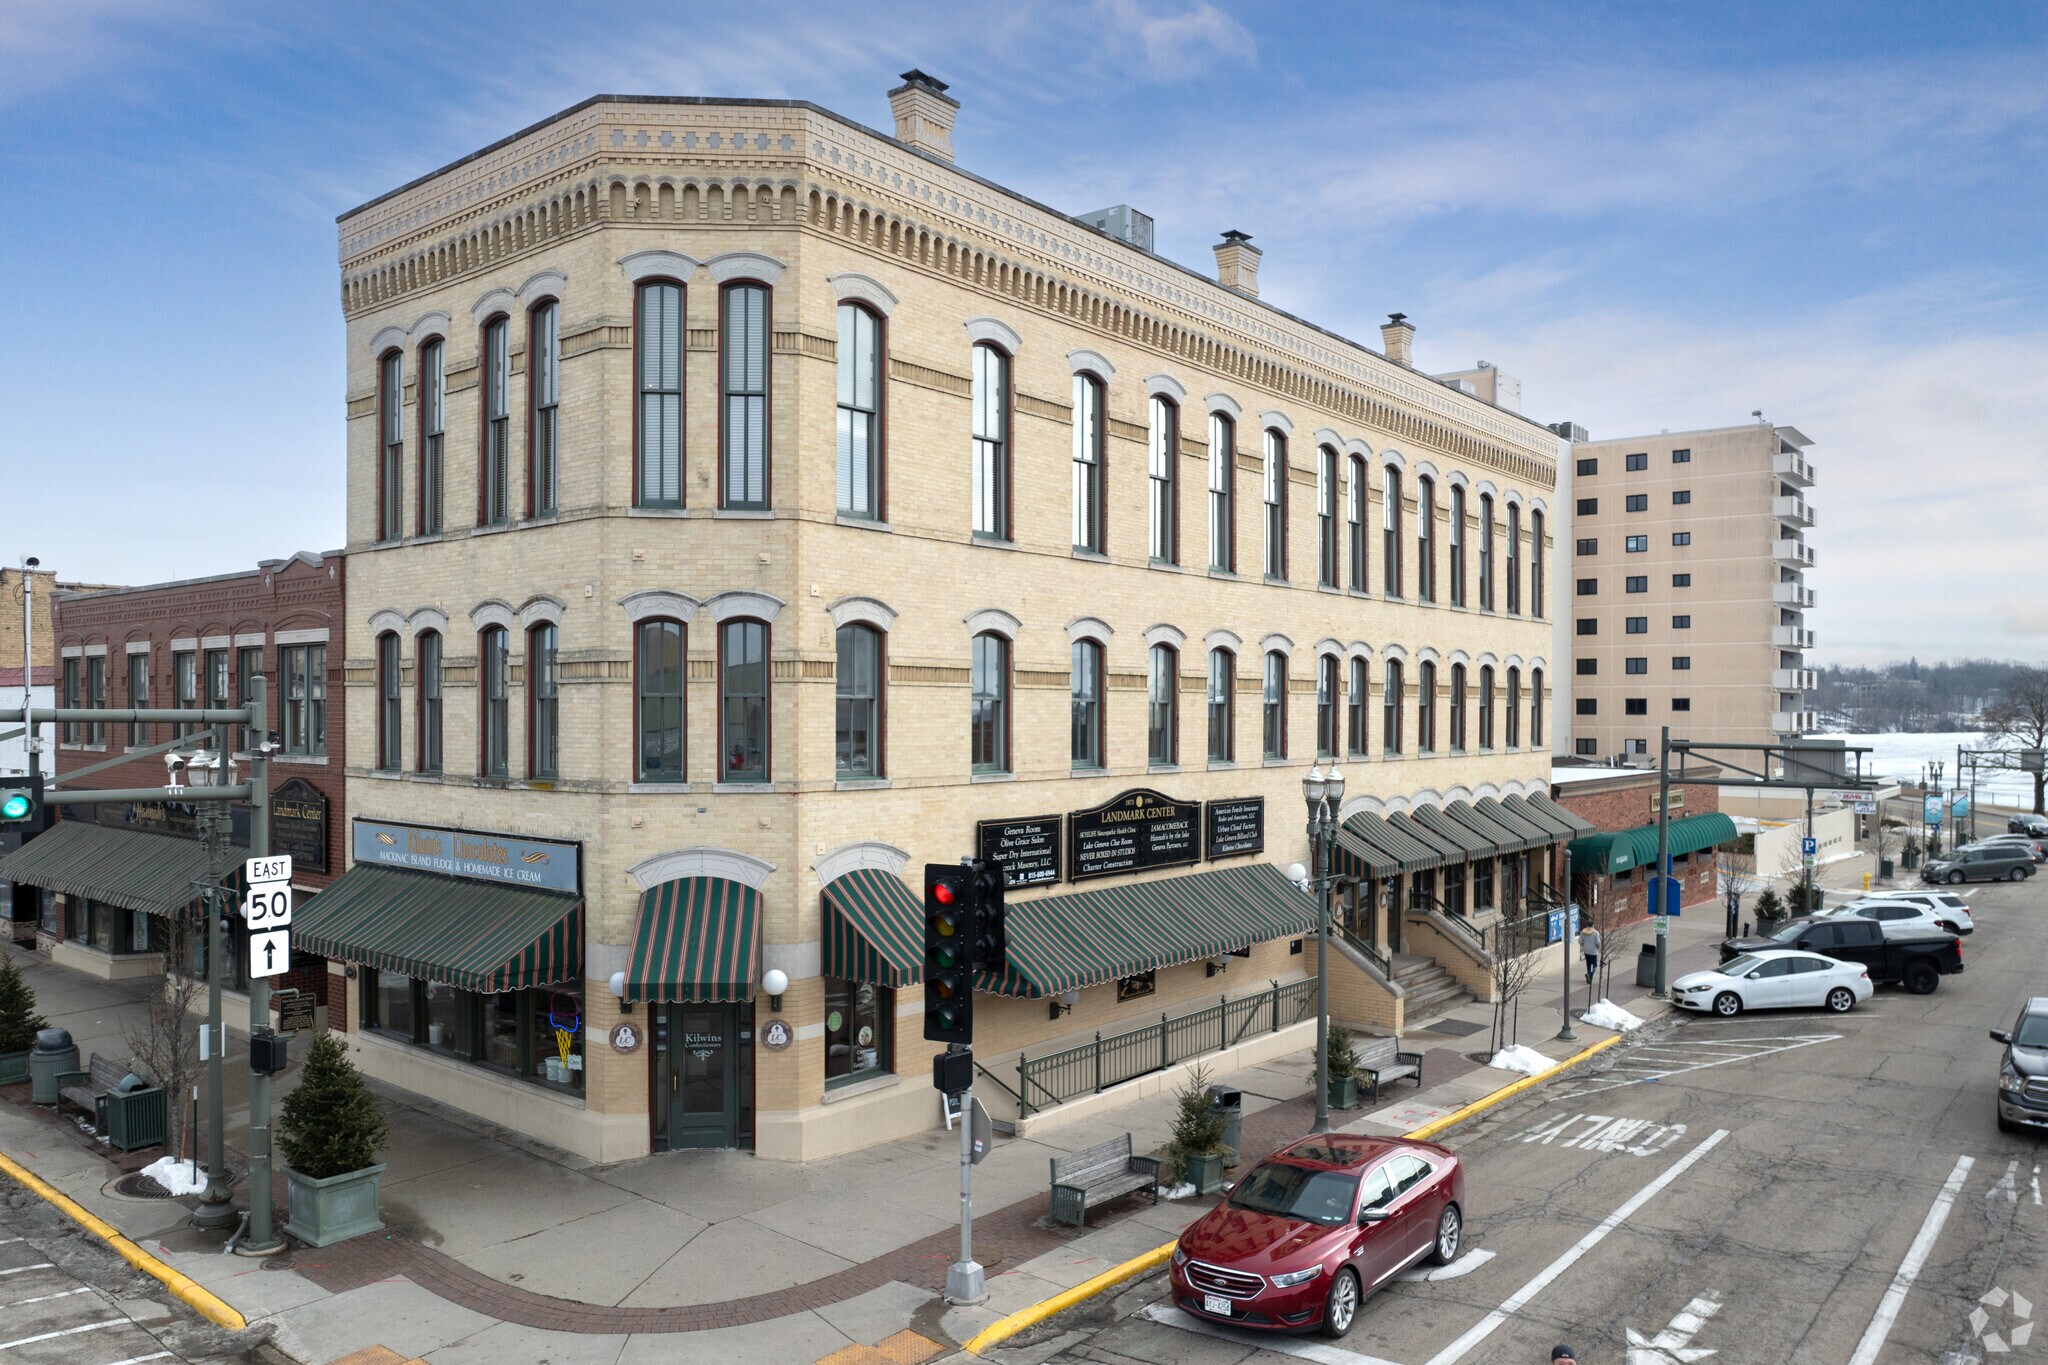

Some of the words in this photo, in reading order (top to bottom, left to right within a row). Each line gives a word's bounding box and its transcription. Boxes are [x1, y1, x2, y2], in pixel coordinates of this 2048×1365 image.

[273, 802, 301, 818] Landmark
[302, 804, 322, 820] Center
[1101, 809, 1145, 823] LANDMARK
[1147, 806, 1176, 819] CENTER
[1232, 806, 1243, 814] Family
[1004, 827, 1024, 836] Geneva
[1025, 825, 1042, 834] Room
[1230, 823, 1242, 832] Cloud
[1242, 823, 1256, 831] Factory
[1001, 839, 1014, 848] Olive
[1031, 836, 1045, 845] Salon
[1150, 834, 1169, 842] Hannah's
[1169, 833, 1174, 841] by
[1182, 831, 1190, 839] lake
[407, 830, 443, 857] Kilwin's
[453, 834, 510, 865] Chocolates
[1083, 841, 1094, 850] Lake
[1094, 840, 1110, 849] Geneva
[1110, 839, 1120, 847] Clue
[1121, 838, 1133, 846] Room
[1152, 843, 1166, 852] Geneva
[1235, 842, 1253, 850] Chocolates
[1805, 840, 1814, 850] P
[993, 852, 1008, 861] Super
[1009, 851, 1019, 859] Dry
[1020, 846, 1052, 858] International
[1080, 852, 1096, 862] NEVER
[1096, 850, 1111, 860] BOXED
[1111, 849, 1117, 857] IN
[1117, 847, 1136, 857] STUDIOS
[380, 851, 408, 865] MACKINAC
[410, 855, 431, 867] ISLAND
[433, 858, 453, 870] FUDGE
[456, 862, 461, 871] &
[464, 863, 501, 877] HOMEMADE
[504, 868, 514, 879] ICE
[517, 870, 541, 883] CREAM
[1041, 858, 1052, 867] LLC
[1083, 863, 1102, 872] Charter
[1103, 859, 1133, 870] Construction
[254, 862, 286, 878] EAST
[252, 892, 287, 921] 50
[619, 1036, 632, 1045] LC
[685, 1034, 722, 1043] Kilwins
[772, 1034, 784, 1042] LC
